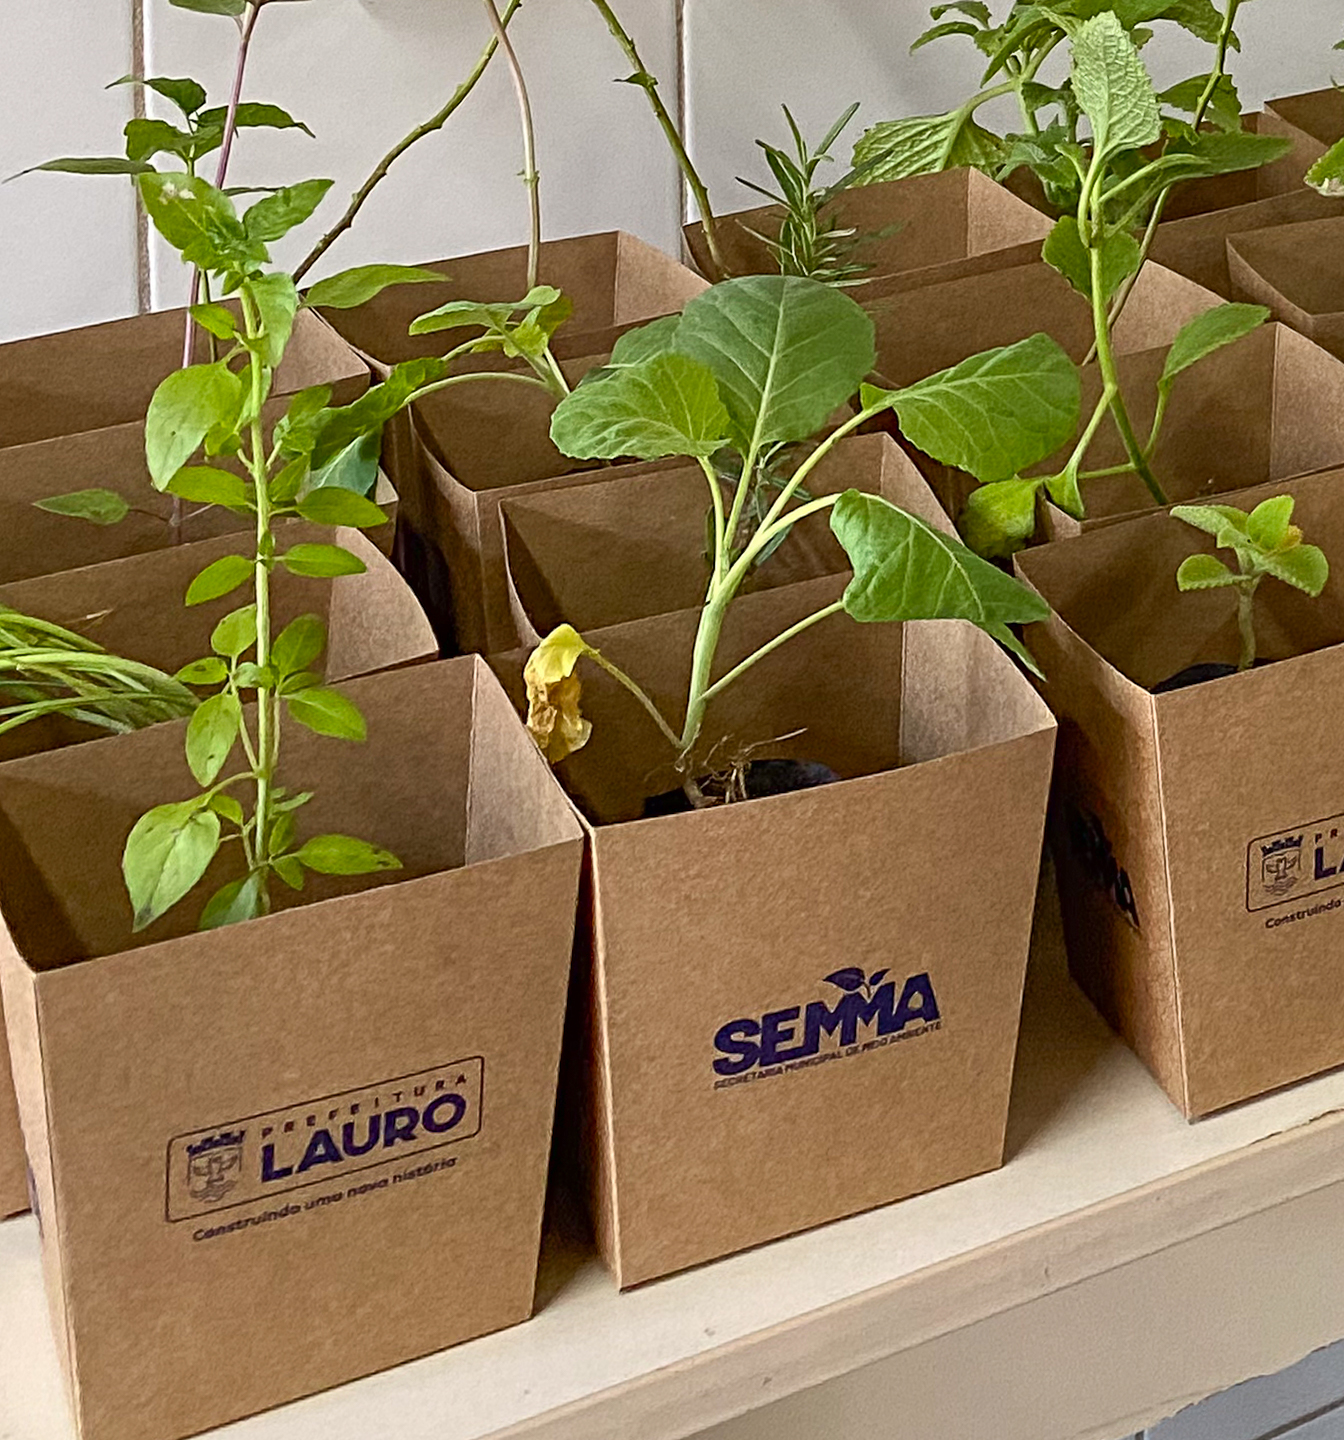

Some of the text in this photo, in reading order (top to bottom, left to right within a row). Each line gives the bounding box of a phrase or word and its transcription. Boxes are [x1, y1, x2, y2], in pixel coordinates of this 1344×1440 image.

[1265, 897, 1342, 930] Construindo
[712, 970, 941, 1076] SEMMA
[261, 1074, 468, 1140] PREFEITURA
[713, 1065, 784, 1091] SECRETARIA
[260, 1092, 467, 1183] LAURO
[192, 1157, 459, 1242] Construindo uma nova história
